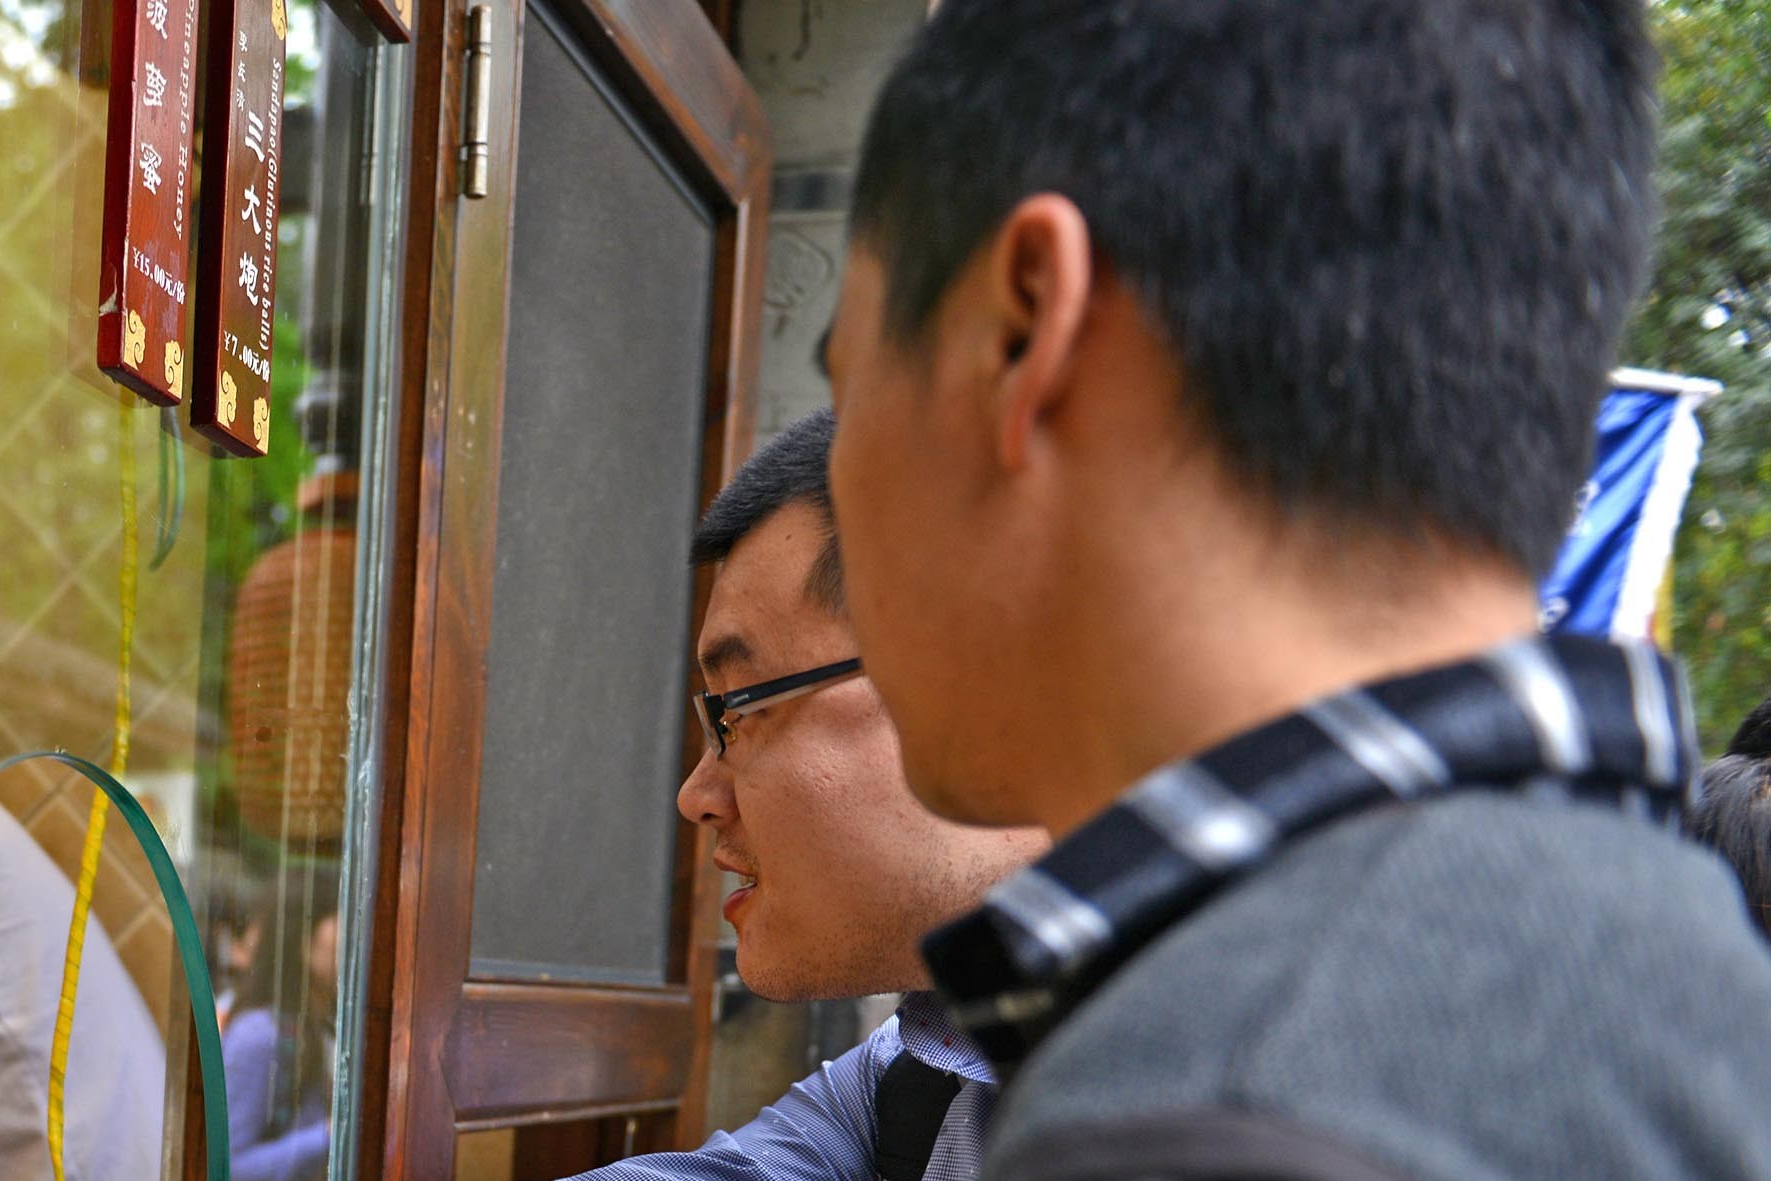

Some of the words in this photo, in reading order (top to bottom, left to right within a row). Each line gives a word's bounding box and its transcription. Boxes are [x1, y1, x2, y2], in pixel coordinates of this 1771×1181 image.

[174, 142, 188, 241] Honey
[238, 111, 266, 307] 三大炮
[262, 256, 273, 293] rice
[259, 296, 272, 351] balls)
